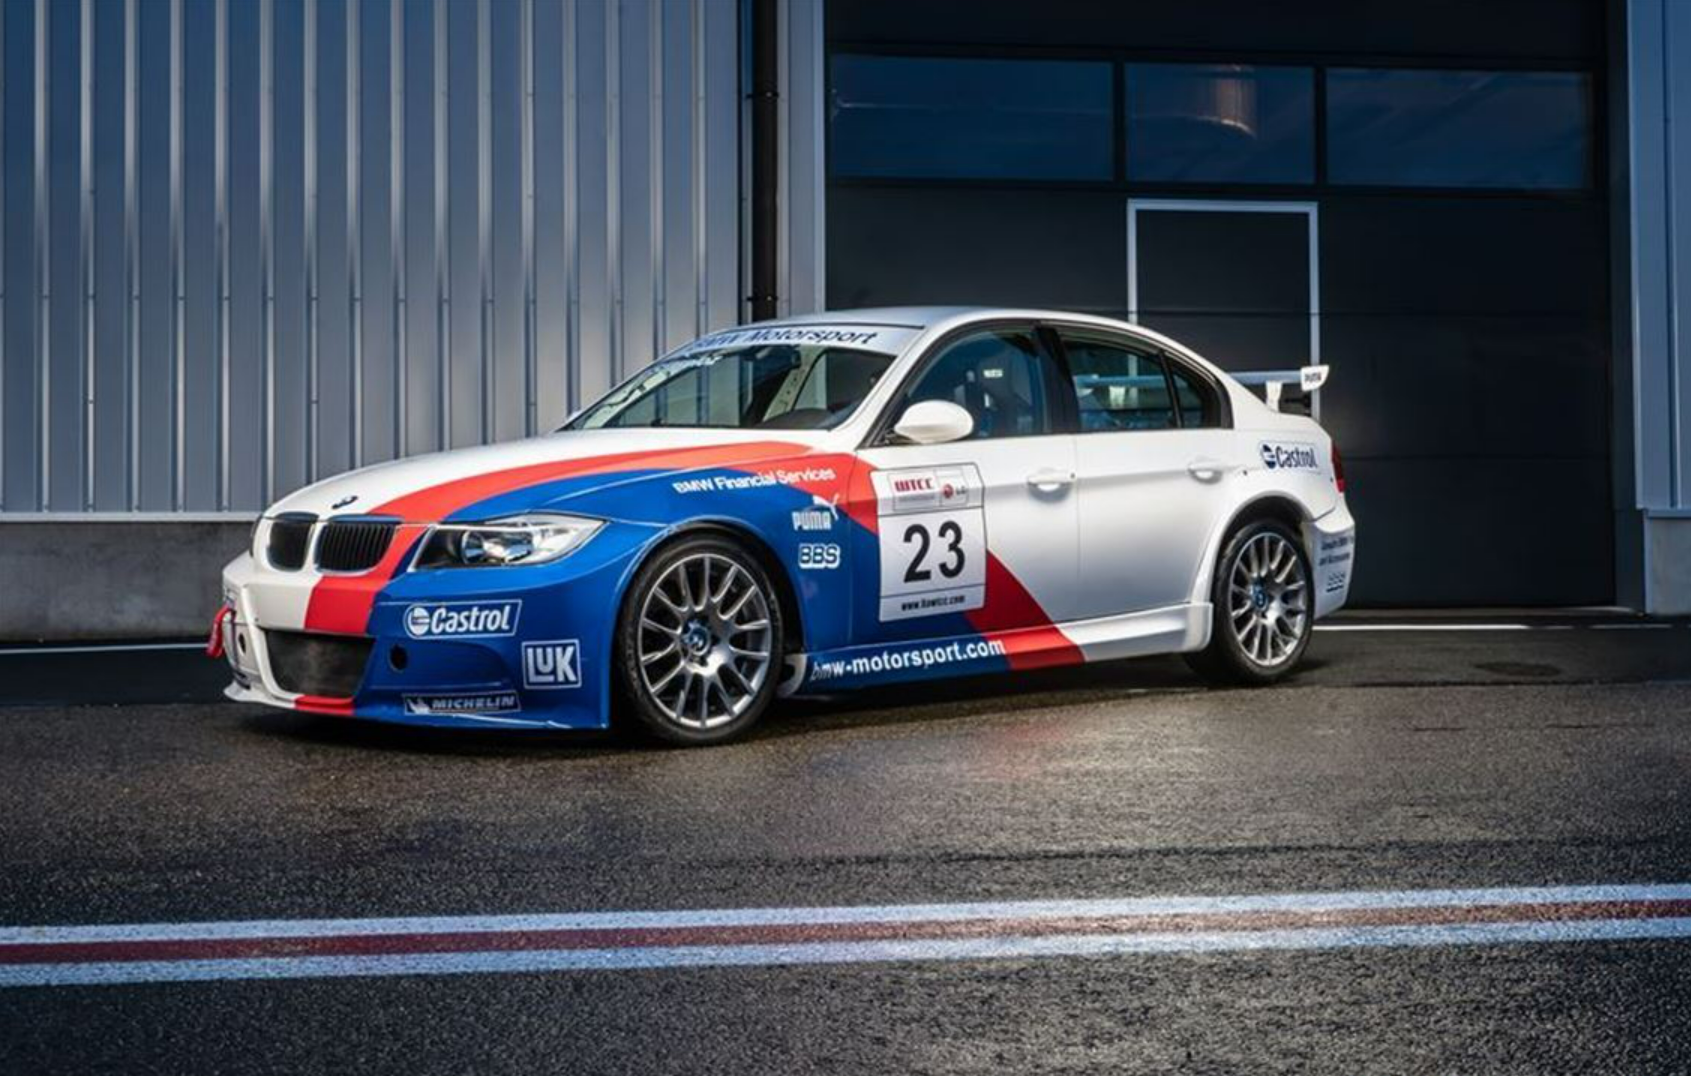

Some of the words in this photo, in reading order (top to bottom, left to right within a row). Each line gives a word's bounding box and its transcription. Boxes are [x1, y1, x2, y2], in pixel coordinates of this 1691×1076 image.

[745, 328, 877, 344] Motorsport
[1275, 445, 1318, 468] Castrol
[672, 477, 714, 494] BMW
[714, 471, 777, 490] Financial
[776, 468, 836, 484] Services
[791, 511, 831, 531] PUMA
[799, 543, 840, 569] BBS
[903, 520, 966, 584] 23
[431, 604, 511, 634] Castrol
[809, 639, 1006, 682] bmw-motorsport.com
[432, 696, 515, 709] MICHELIN
